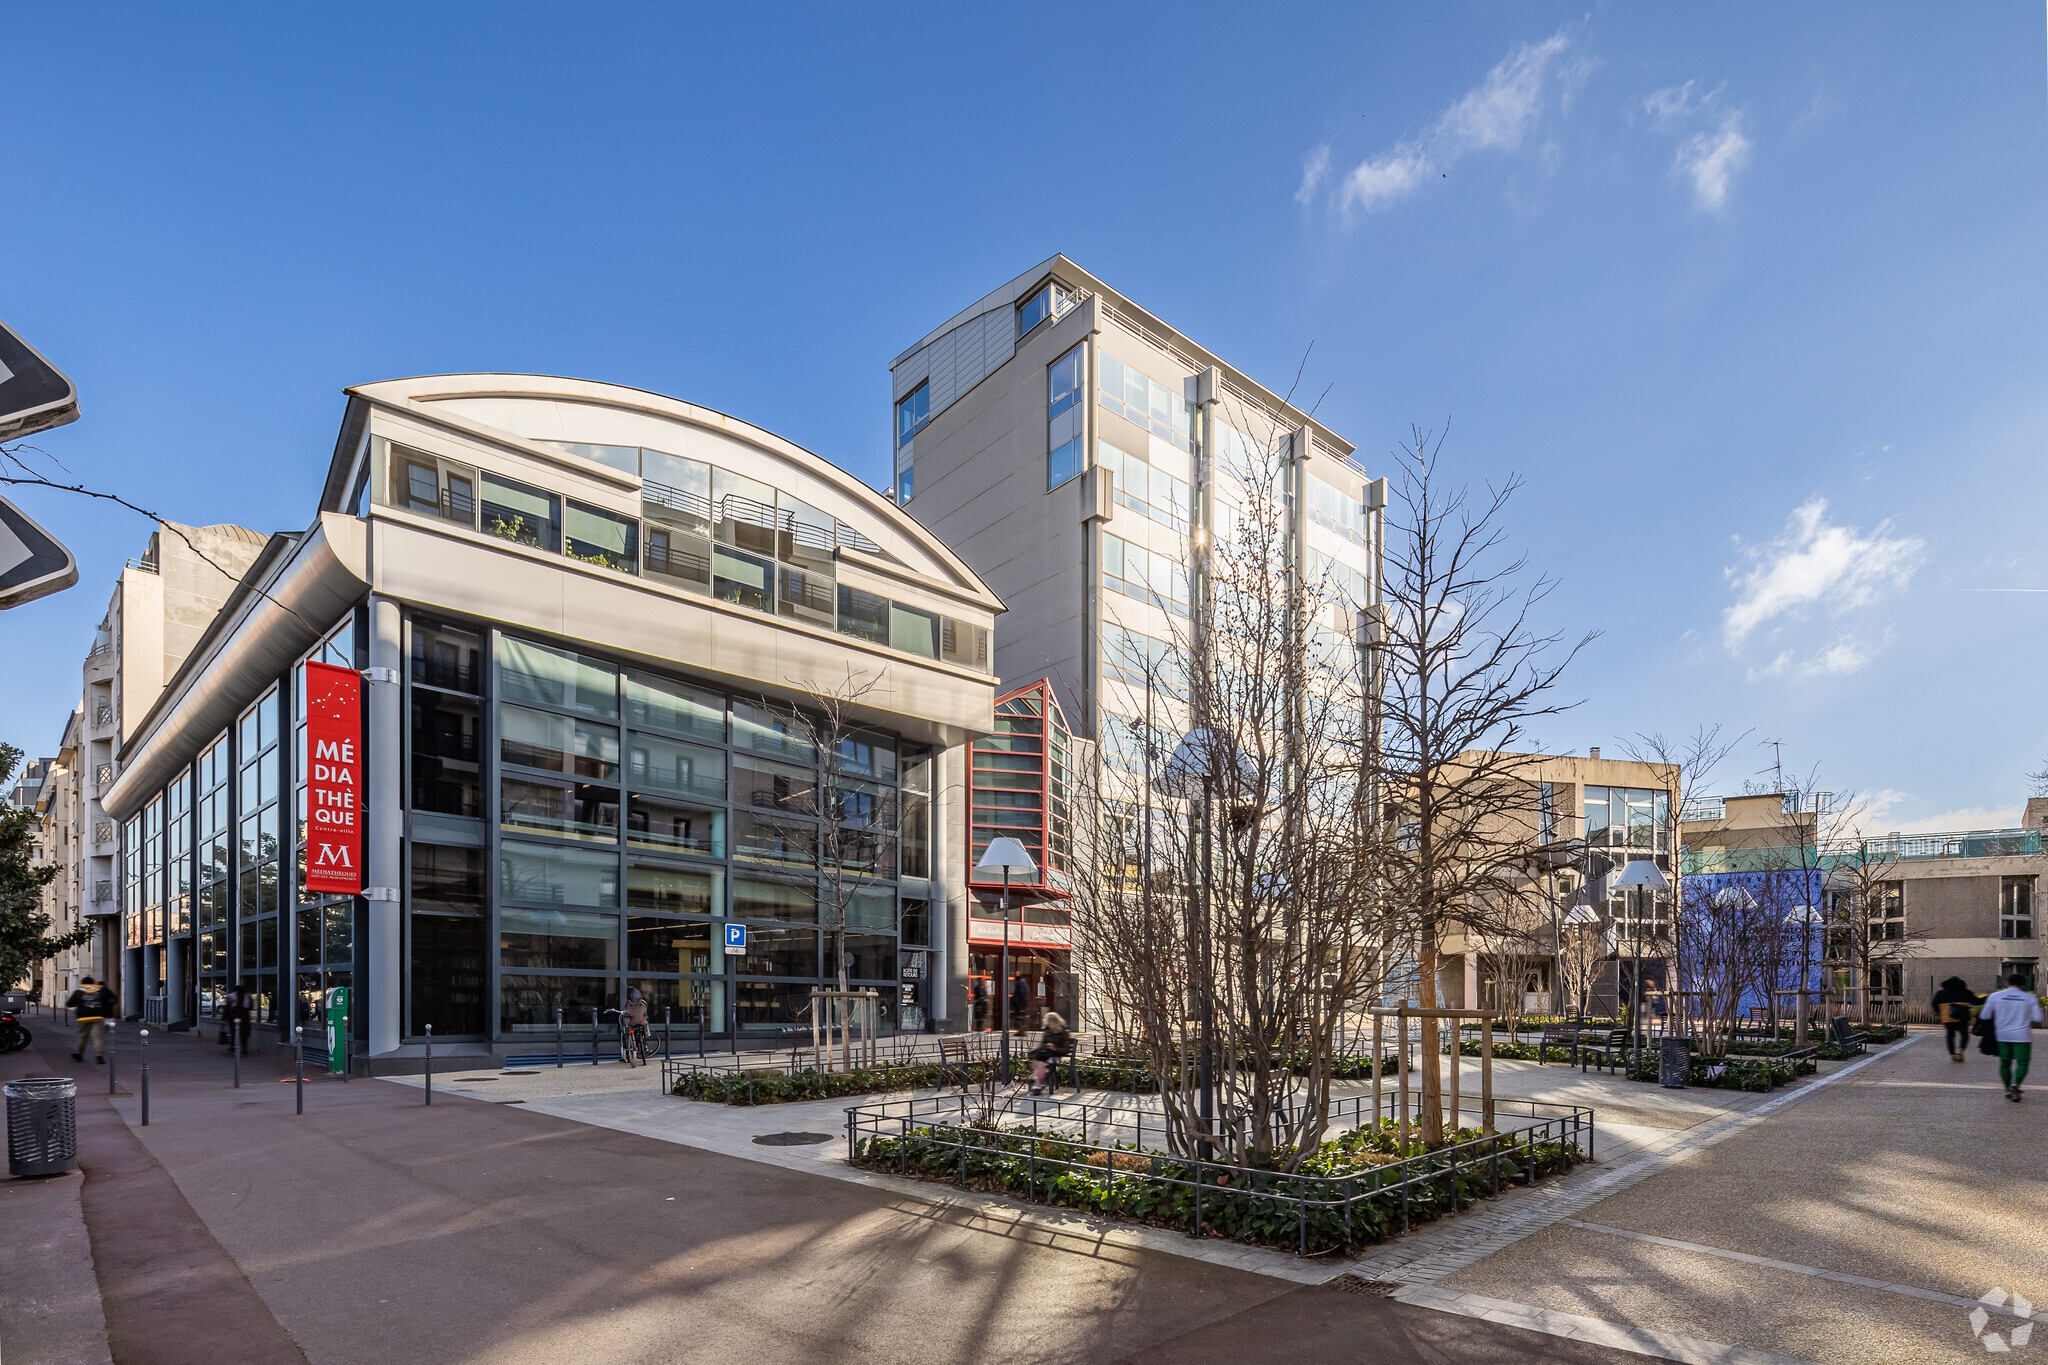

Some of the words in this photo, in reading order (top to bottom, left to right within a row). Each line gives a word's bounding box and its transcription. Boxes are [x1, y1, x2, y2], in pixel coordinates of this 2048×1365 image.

[315, 738, 354, 764] MÉ
[315, 764, 353, 785] DIA
[315, 788, 354, 809] THÈ
[315, 808, 354, 826] QUE
[315, 826, 354, 834] Centre-ville
[315, 843, 353, 868] M
[731, 928, 740, 942] P
